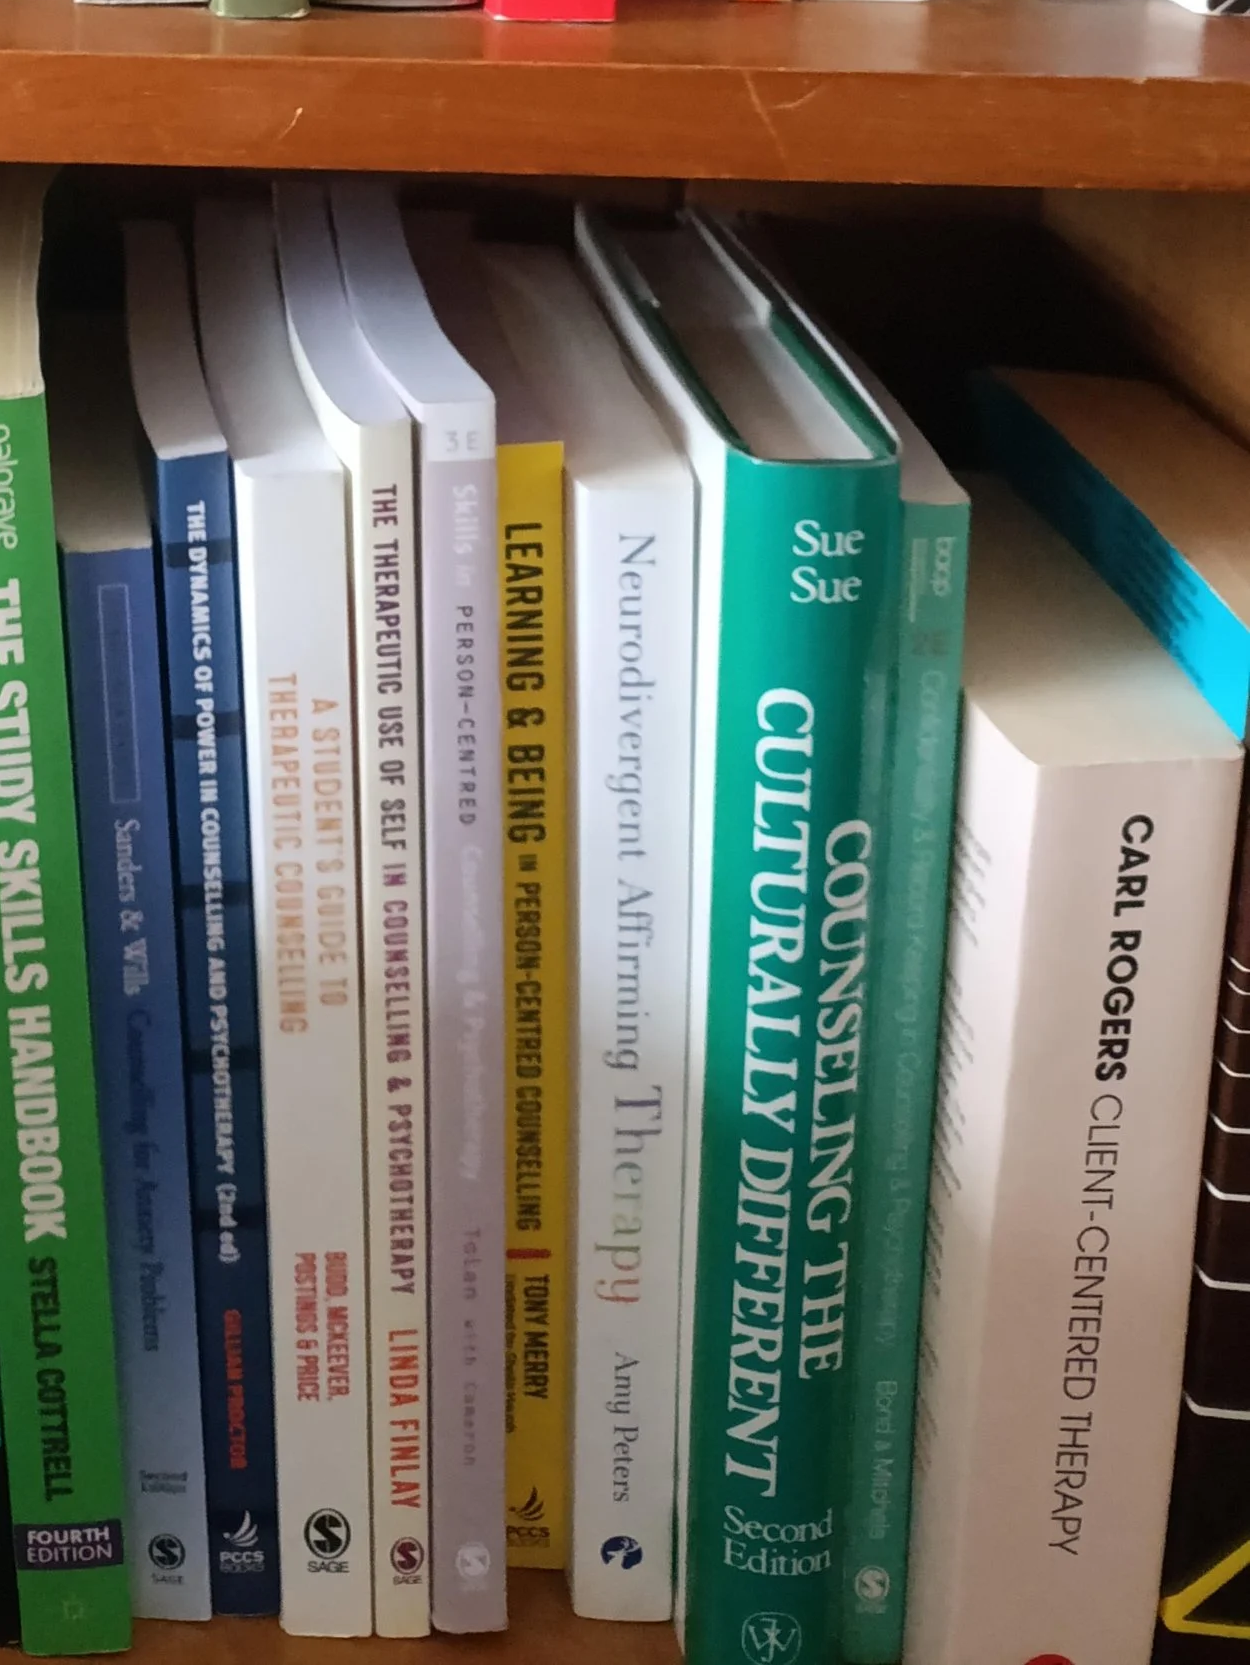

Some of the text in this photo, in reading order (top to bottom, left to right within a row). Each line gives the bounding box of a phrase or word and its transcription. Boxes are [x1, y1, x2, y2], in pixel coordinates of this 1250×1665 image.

[789, 565, 863, 604] Sue
[792, 519, 865, 557] Sue
[593, 532, 663, 1305] Neurodivergent Affirming Therapy
[7, 1004, 67, 1244] HANDBOOK
[725, 687, 814, 1497] CULTURALLY DIFFERENT
[798, 818, 872, 1380] COUNSELING THE
[1048, 814, 1154, 1556] CARL ROGERS CLIENT-CENTERED THERAPY
[28, 1256, 60, 1362] STELLA
[36, 1365, 73, 1501] COTTRELL
[388, 1329, 422, 1509] LINDA FINLAY
[606, 1350, 640, 1503] Amy Peters
[27, 1526, 110, 1546] FOURTH
[27, 1545, 113, 1563] EDITION
[219, 1551, 265, 1563] PCCS
[306, 1560, 350, 1574] SAGE
[723, 1504, 833, 1543] Second
[723, 1536, 831, 1576] Edition
